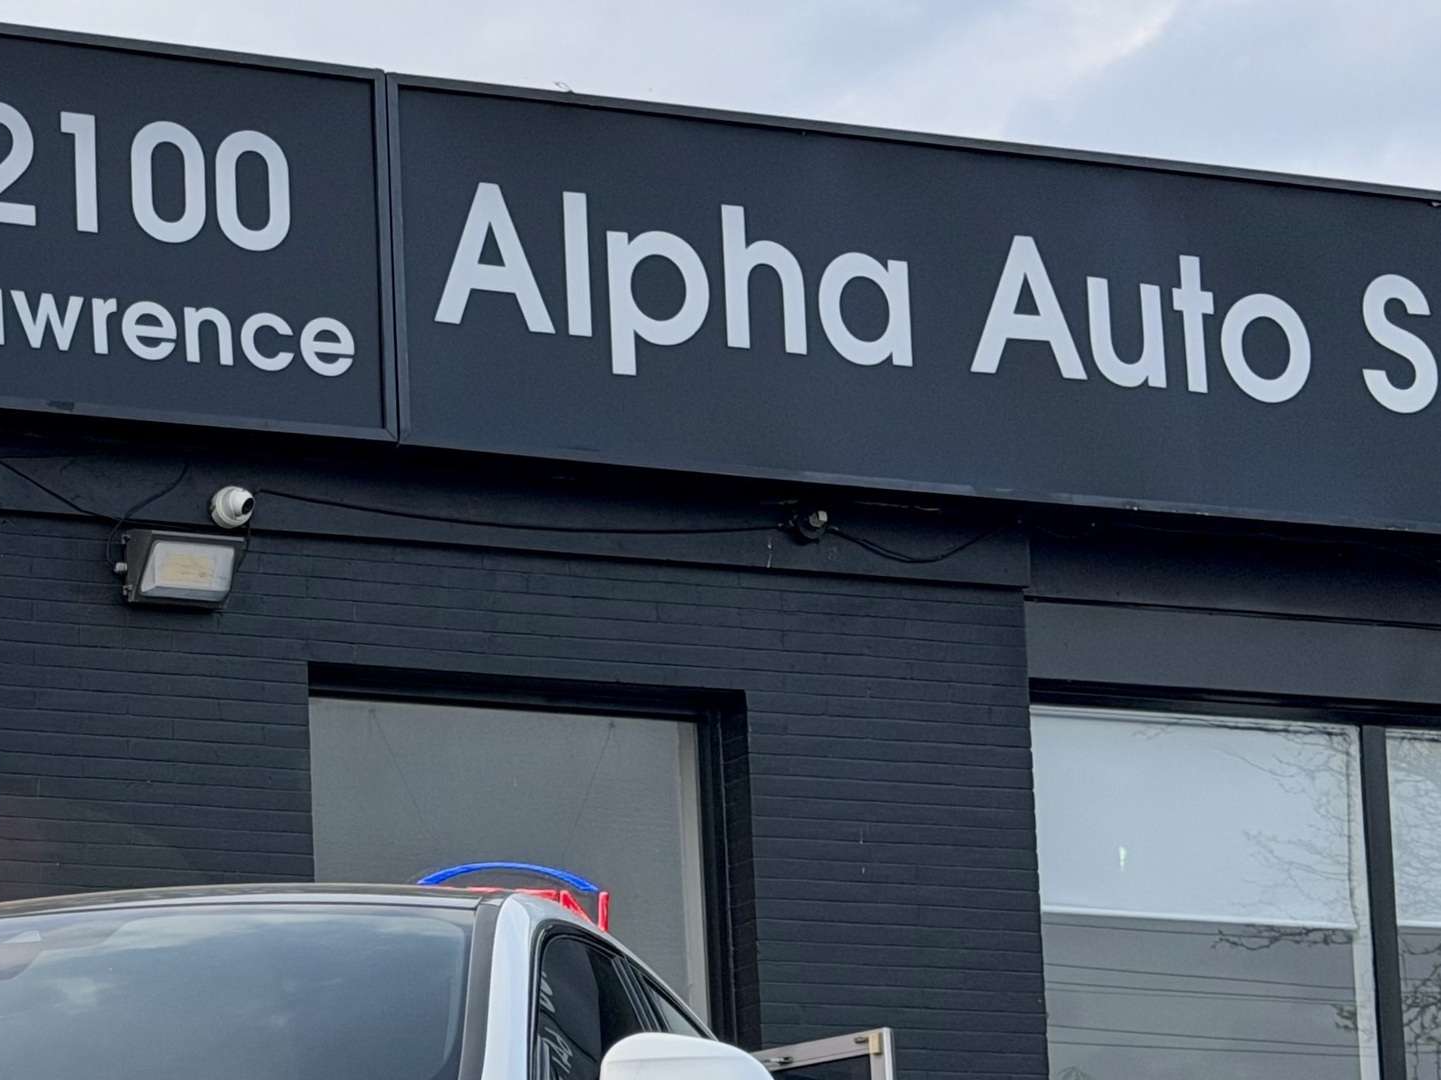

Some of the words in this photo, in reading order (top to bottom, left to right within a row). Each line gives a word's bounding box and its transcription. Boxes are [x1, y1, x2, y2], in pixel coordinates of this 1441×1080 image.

[434, 182, 913, 376] Alpha
[970, 235, 1312, 403] Auto
[1362, 273, 1438, 414] S
